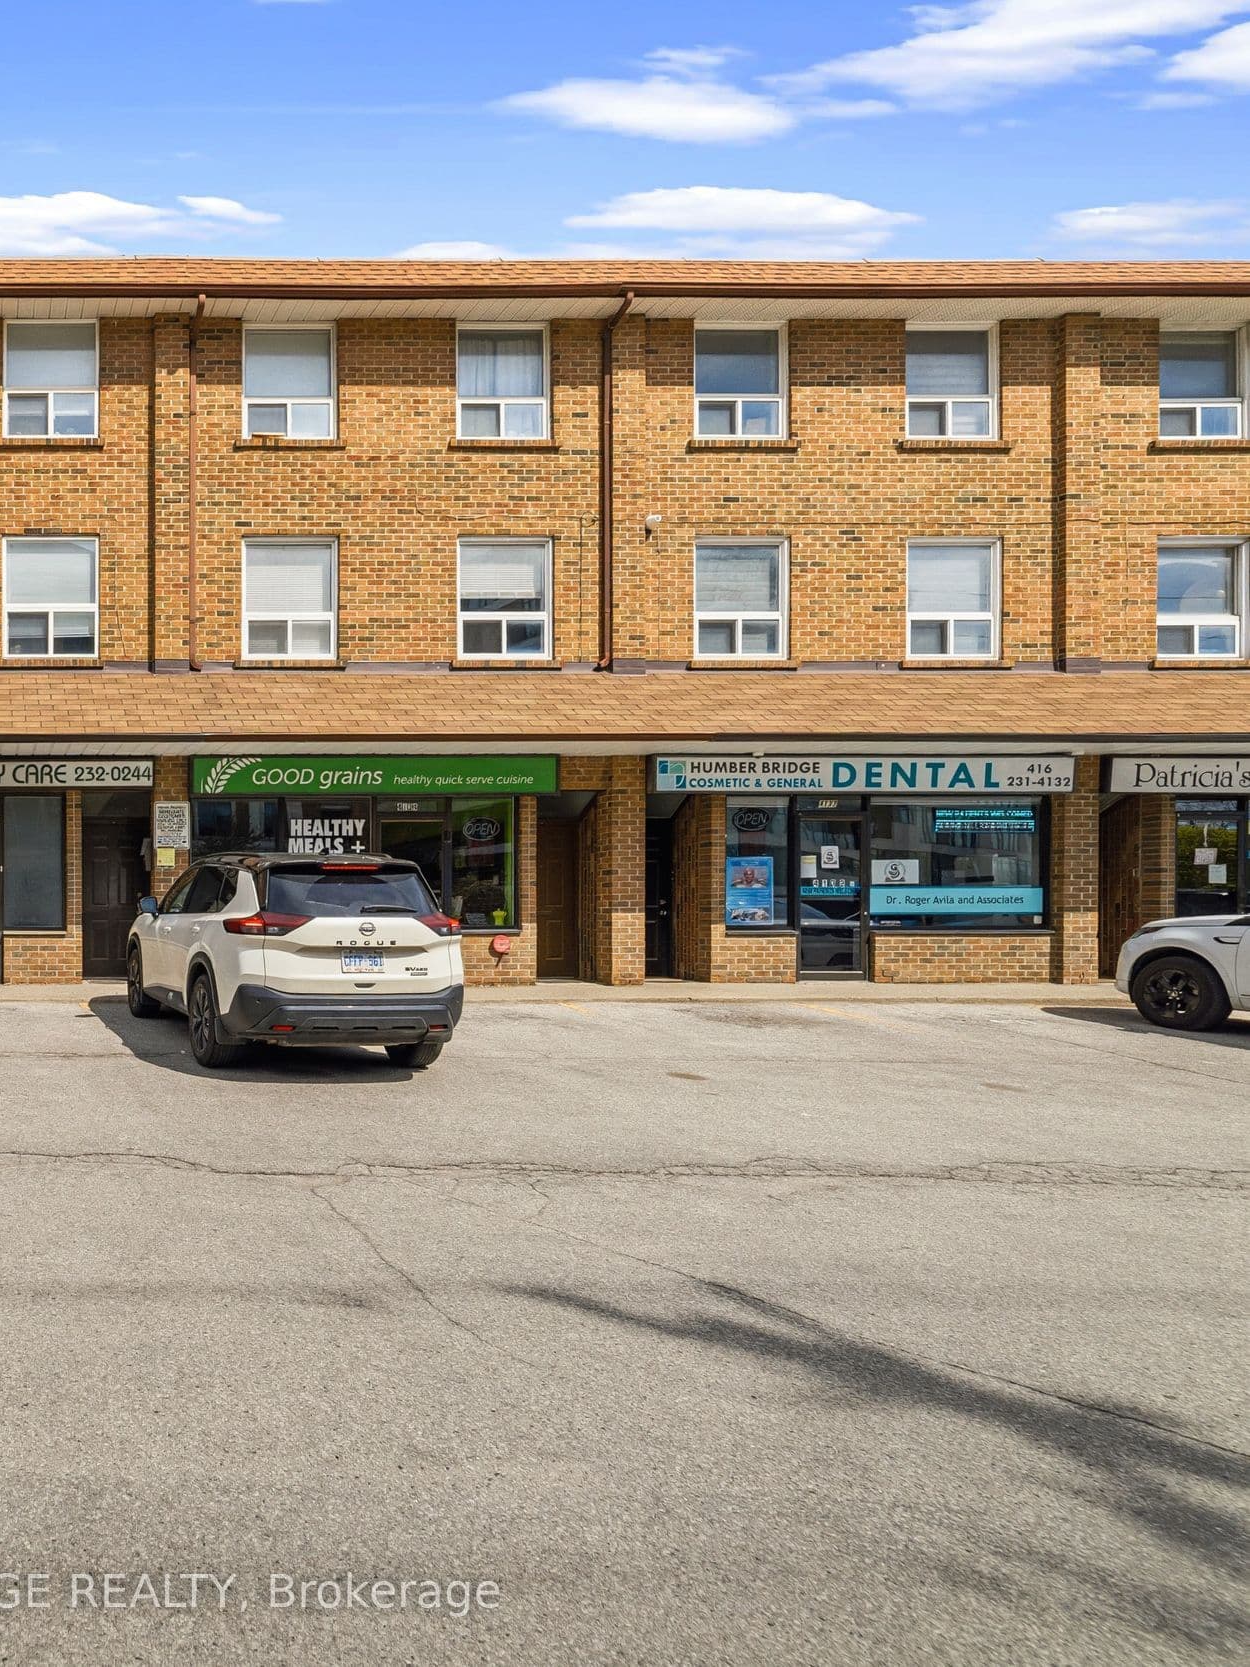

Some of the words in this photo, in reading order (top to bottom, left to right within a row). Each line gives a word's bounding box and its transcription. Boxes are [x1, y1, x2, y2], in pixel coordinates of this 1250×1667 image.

[690, 762, 756, 773] HUMBER
[762, 762, 820, 773] BRIDGE
[1027, 763, 1052, 774] 416
[12, 764, 67, 784] CARE
[74, 766, 151, 781] 232-0244
[252, 768, 315, 785] GOOD
[319, 766, 383, 789] grains
[832, 762, 999, 788] DENTAL
[1133, 761, 1250, 788] Patricia's
[394, 774, 433, 787] healthy
[435, 775, 463, 787] quick
[466, 777, 494, 785] serve
[496, 774, 534, 785] cuisine
[689, 778, 749, 788] COSMETIC
[755, 778, 762, 788] &
[767, 778, 823, 788] GENERAL
[1007, 777, 1071, 787] 231-4132
[734, 813, 767, 825] OPEN
[290, 819, 366, 836] HEALTHY
[466, 823, 496, 835] OPEN
[288, 838, 344, 854] MEALS
[905, 895, 930, 906] Roger
[933, 896, 955, 904] Avila
[958, 896, 975, 904] and
[977, 896, 1024, 904] Associates
